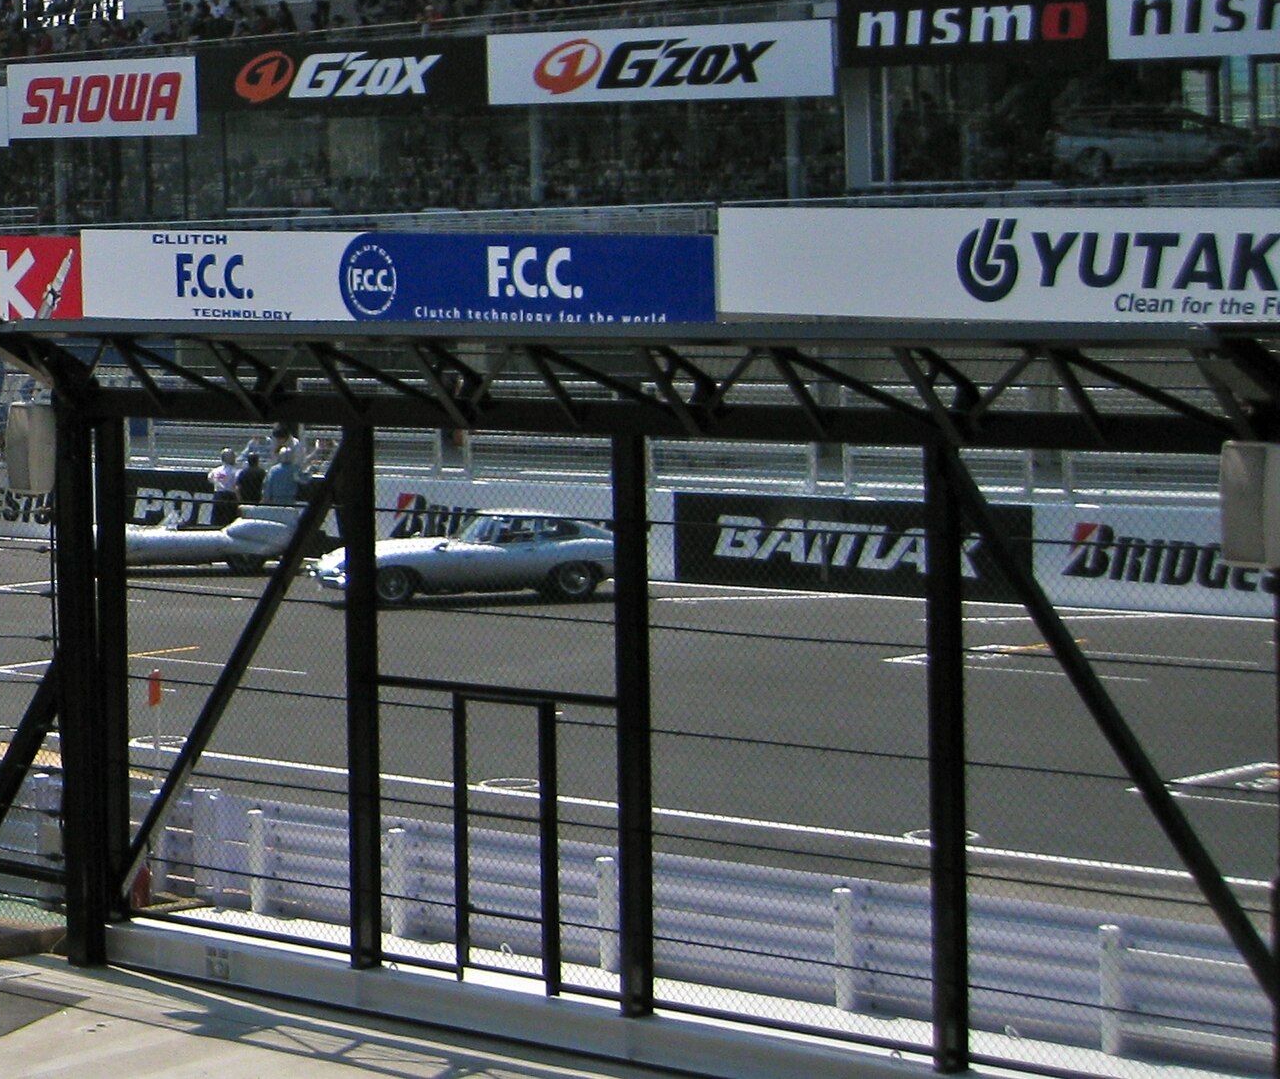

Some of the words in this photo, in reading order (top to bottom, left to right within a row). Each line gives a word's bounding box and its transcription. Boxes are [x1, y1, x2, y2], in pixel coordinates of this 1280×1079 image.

[856, 1, 1088, 48] nismo
[21, 72, 181, 124] SHOWA
[152, 233, 228, 245] CLUTCH
[175, 252, 255, 300] F.C.C.
[352, 268, 394, 293] F.C.C.
[487, 245, 584, 299] F.C.C.
[192, 307, 293, 321] TECHNOLOGY
[414, 306, 461, 320] Clutch
[559, 310, 582, 323] for
[590, 310, 614, 323] the
[621, 311, 667, 323] world
[1114, 293, 1175, 314] Clean
[1181, 295, 1213, 315] for
[1219, 296, 1255, 315] the
